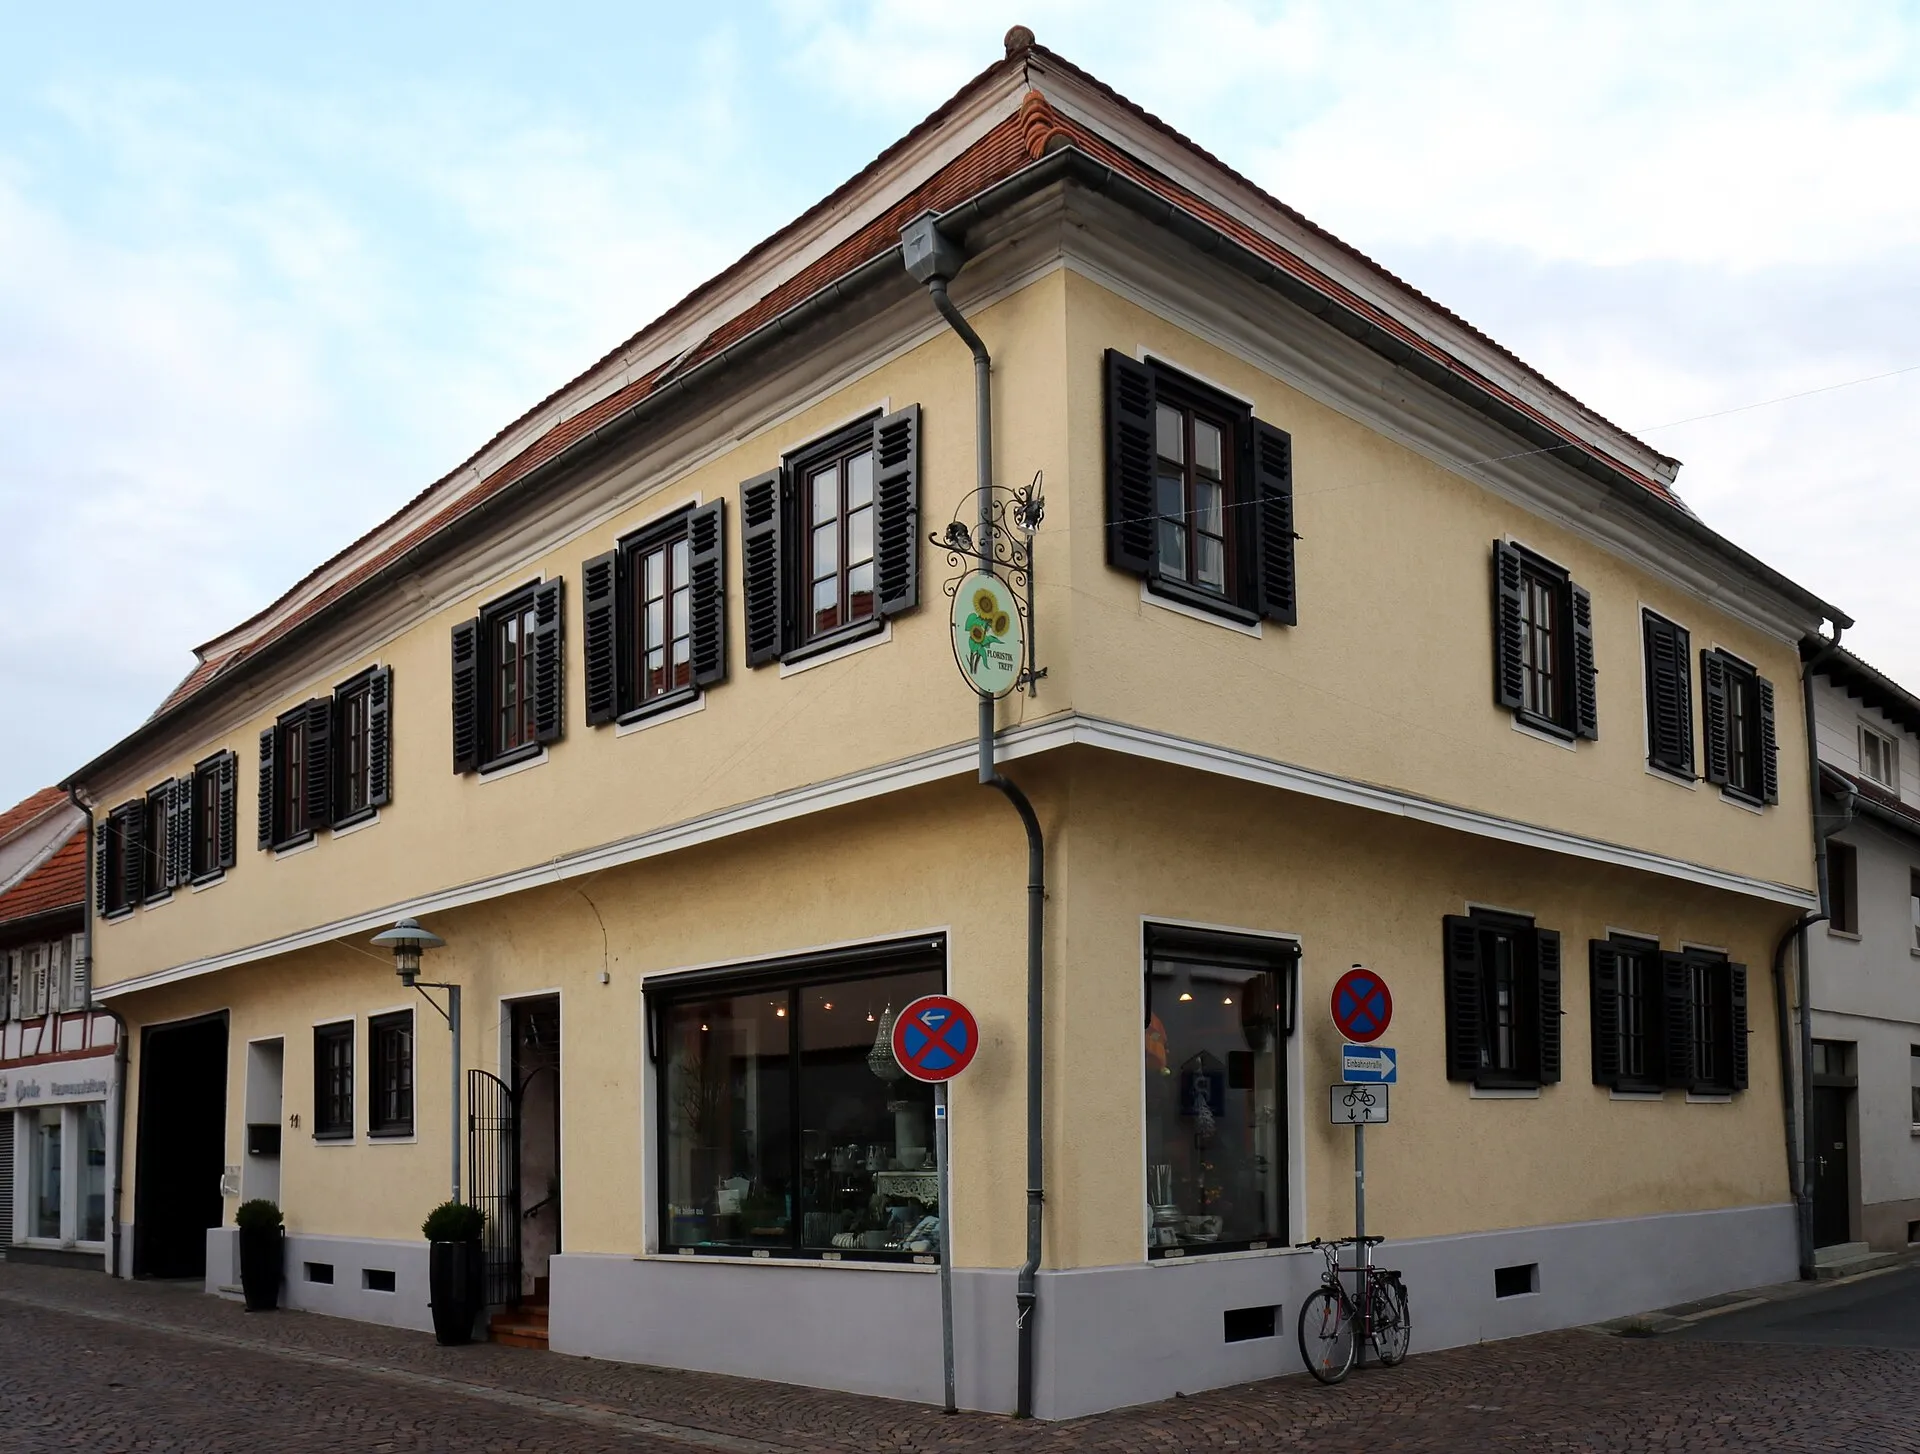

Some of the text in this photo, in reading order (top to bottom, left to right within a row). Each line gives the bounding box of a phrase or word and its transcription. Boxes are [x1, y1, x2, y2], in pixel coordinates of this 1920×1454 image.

[987, 649, 1013, 662] FLORISTIK
[1346, 1058, 1383, 1069] Einbahnstraße
[289, 1113, 299, 1129] 11
